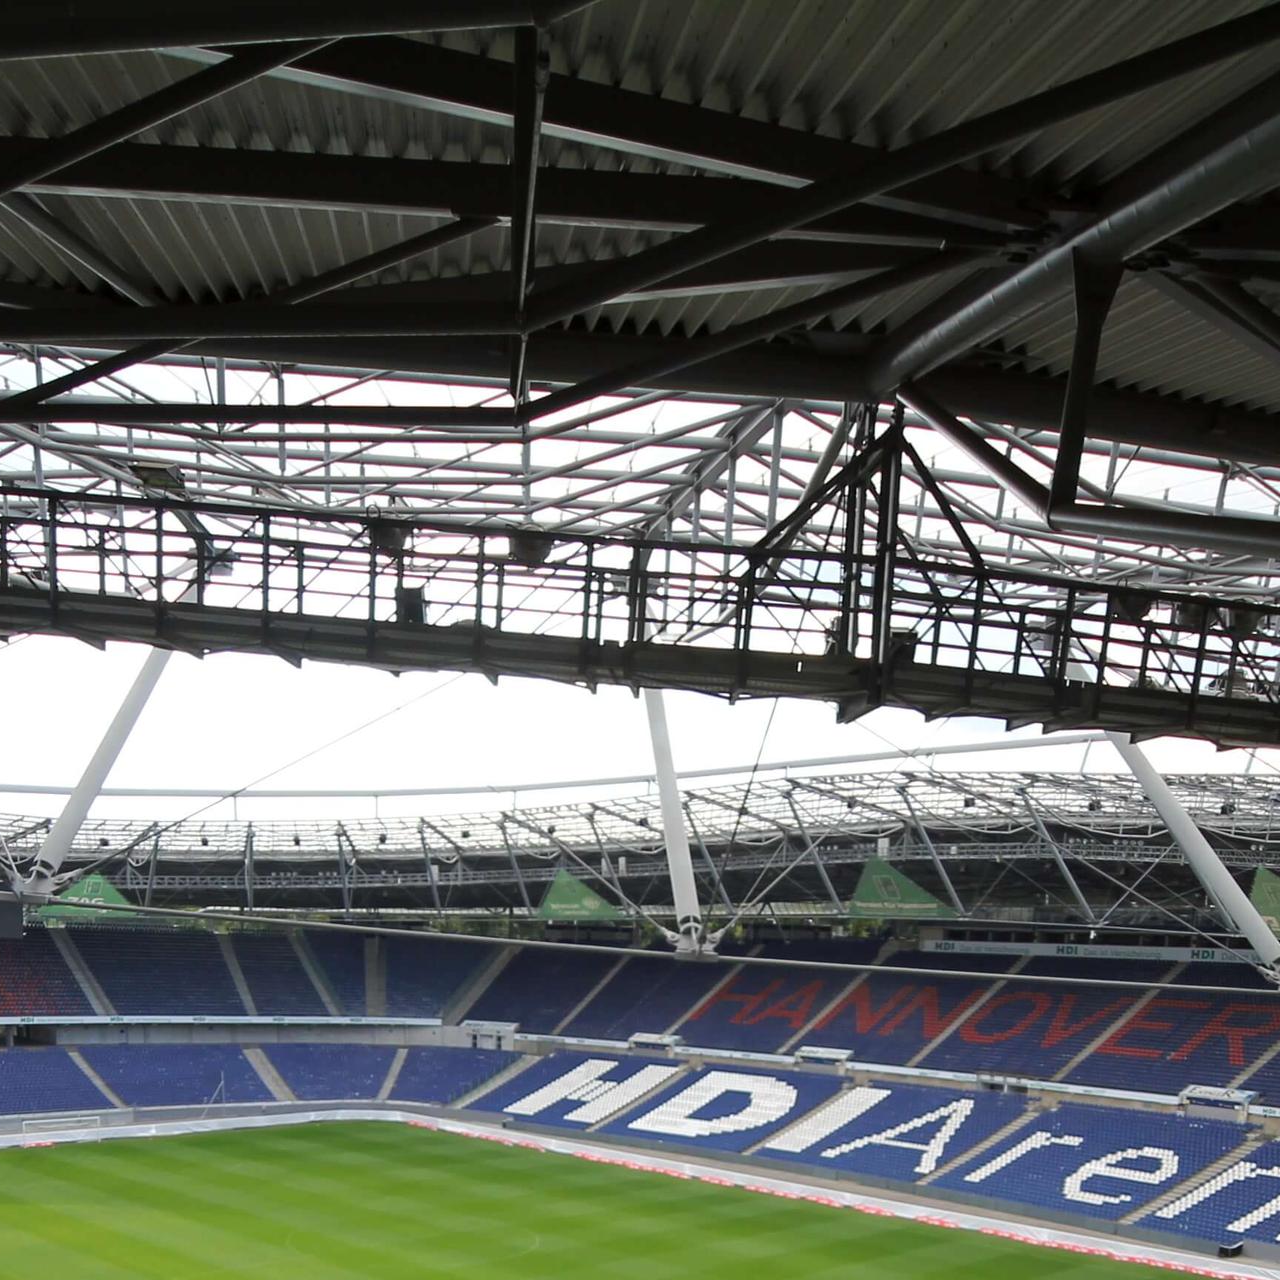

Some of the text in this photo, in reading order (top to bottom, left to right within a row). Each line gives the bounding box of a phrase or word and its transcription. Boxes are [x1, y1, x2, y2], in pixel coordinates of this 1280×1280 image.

[935, 942, 955, 950] HDI
[1056, 945, 1078, 955] HDI
[1191, 950, 1215, 960] HDI
[503, 1059, 892, 1153] HDI
